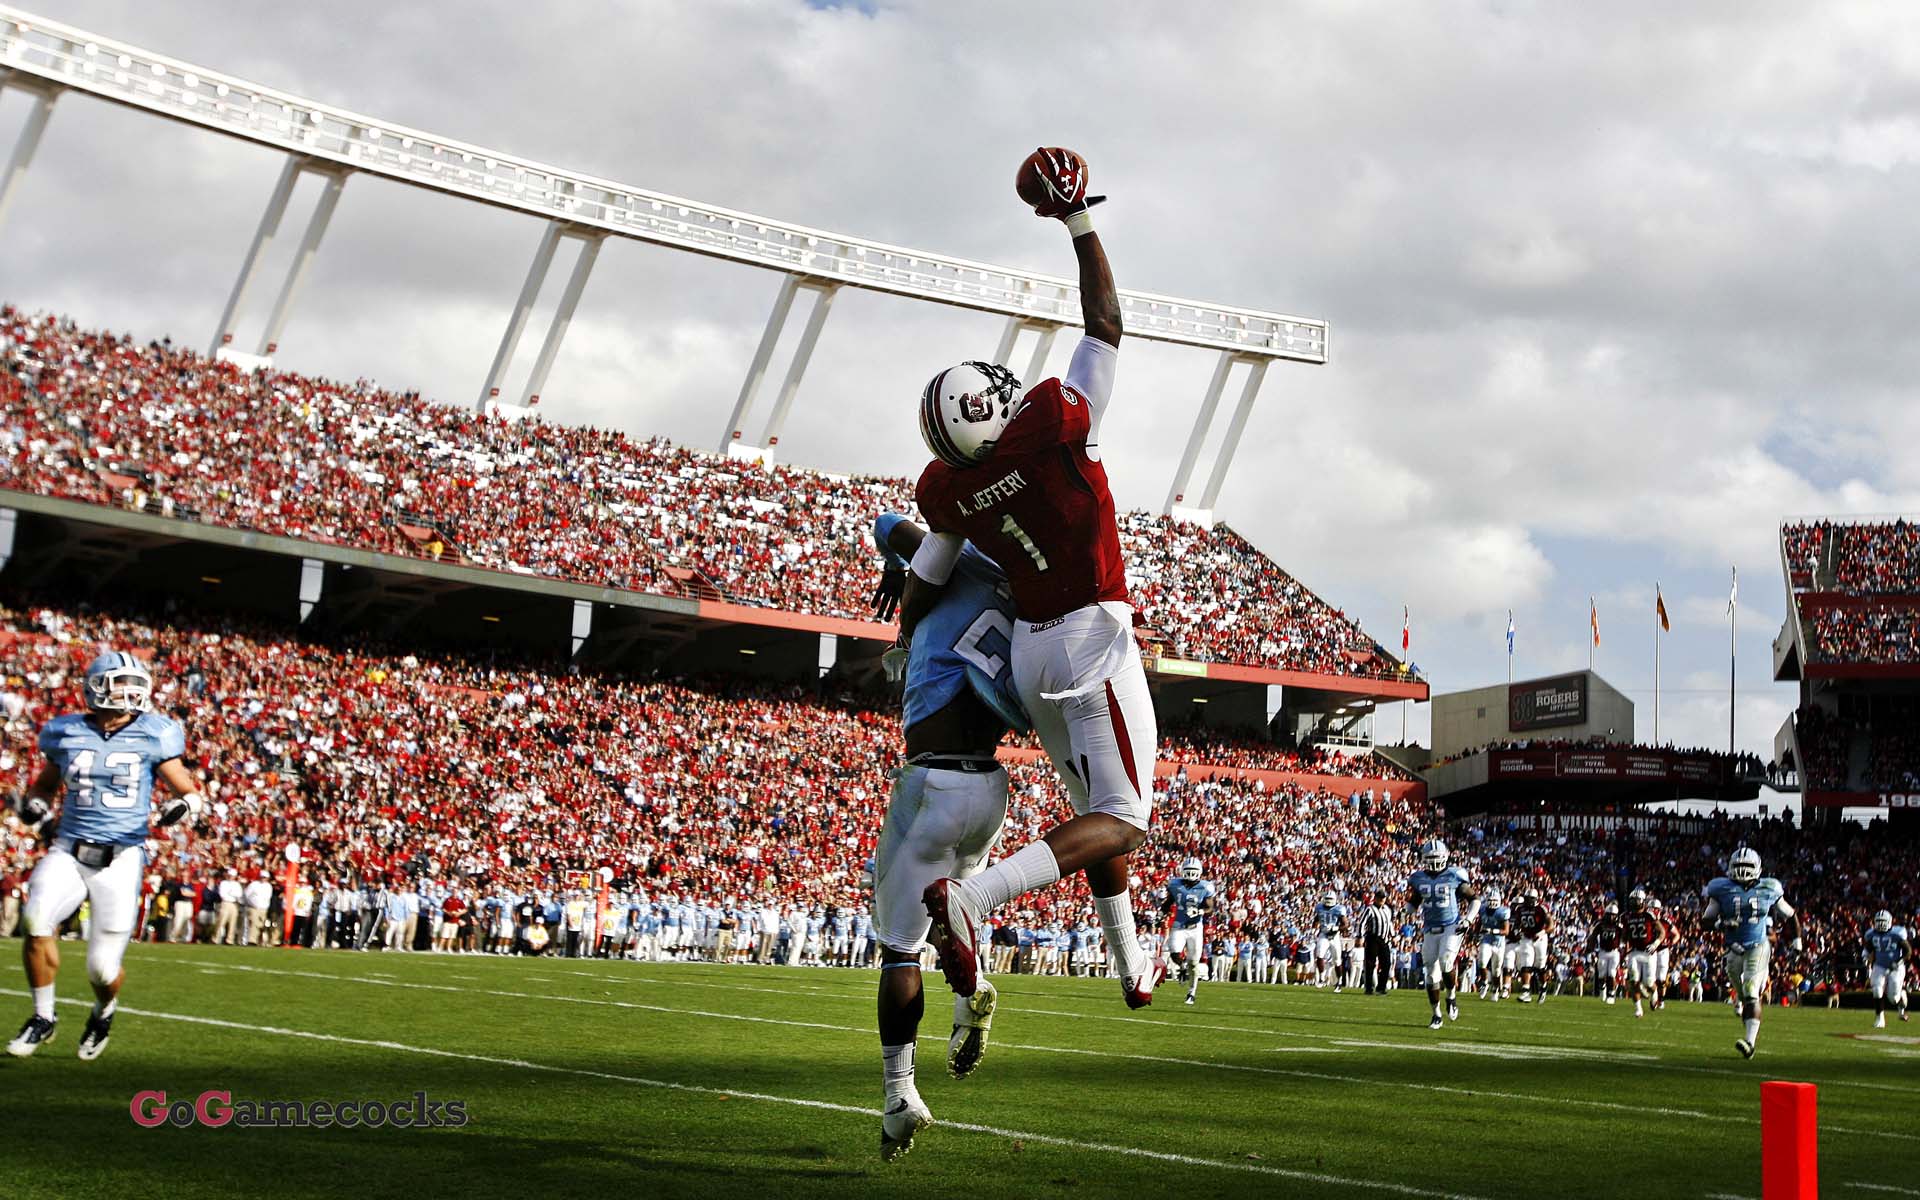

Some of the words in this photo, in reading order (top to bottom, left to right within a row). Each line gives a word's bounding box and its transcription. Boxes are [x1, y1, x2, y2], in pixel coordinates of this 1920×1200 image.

[956, 500, 972, 518] A.
[973, 470, 1027, 511] JEFFERY
[1001, 513, 1049, 572] 1
[1535, 690, 1579, 707] ROGERS
[63, 750, 142, 809] 43
[1419, 883, 1451, 908] 29
[1732, 895, 1759, 924] 11
